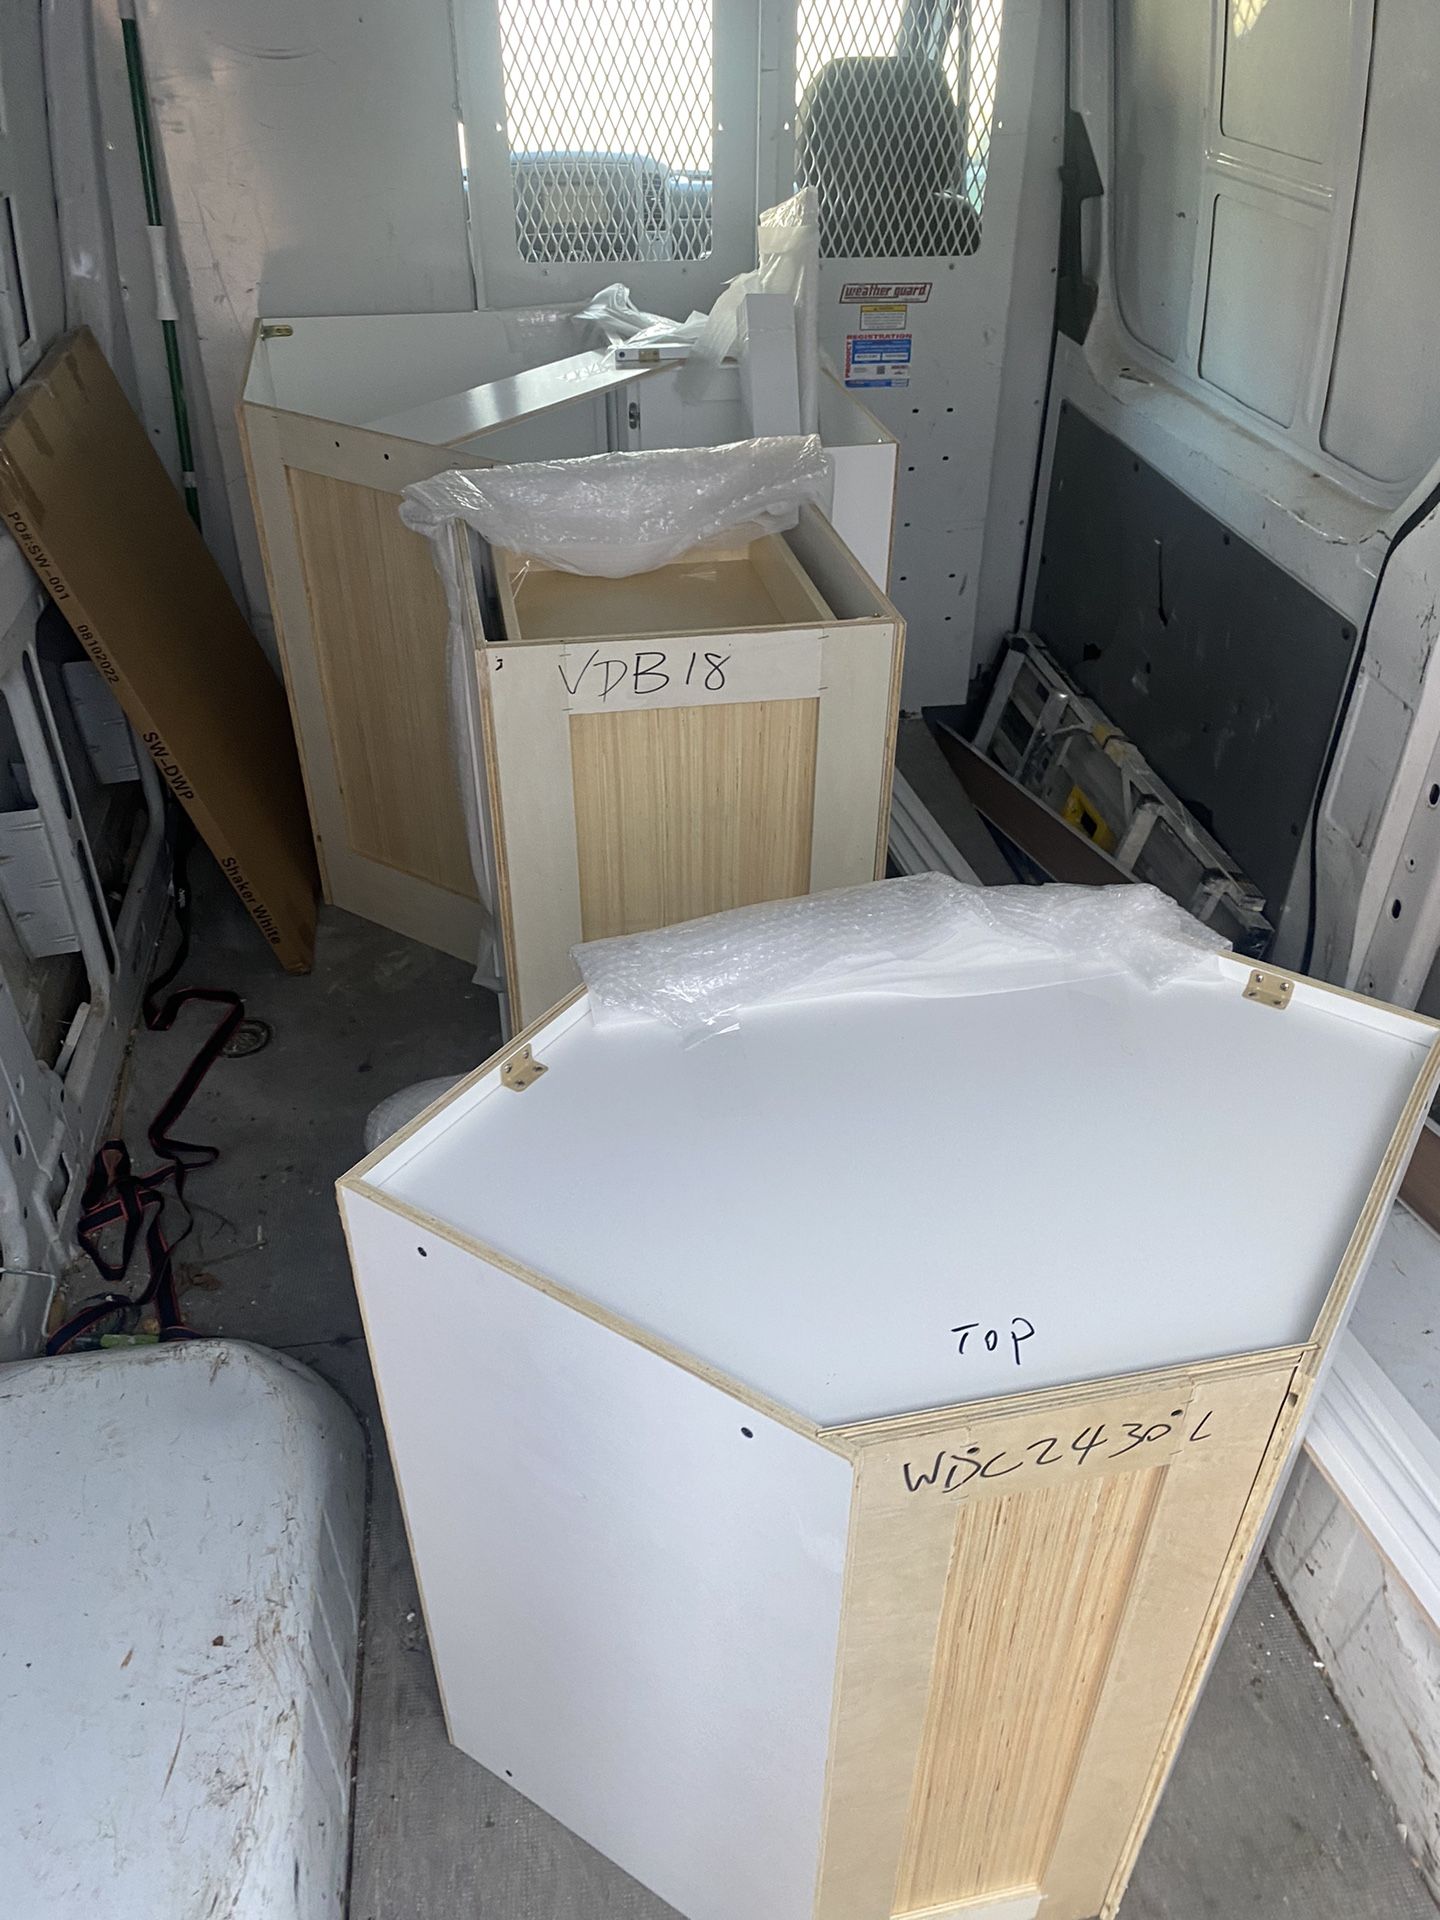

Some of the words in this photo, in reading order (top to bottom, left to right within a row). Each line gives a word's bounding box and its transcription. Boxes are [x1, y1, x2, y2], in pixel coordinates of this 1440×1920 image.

[845, 284, 892, 296] weather
[894, 284, 926, 297] guard
[8, 511, 70, 600] PO#:SW-001
[77, 624, 120, 684] 08102022
[143, 731, 195, 800] SW-DWP
[222, 857, 256, 904] Shaker
[252, 904, 281, 945] White
